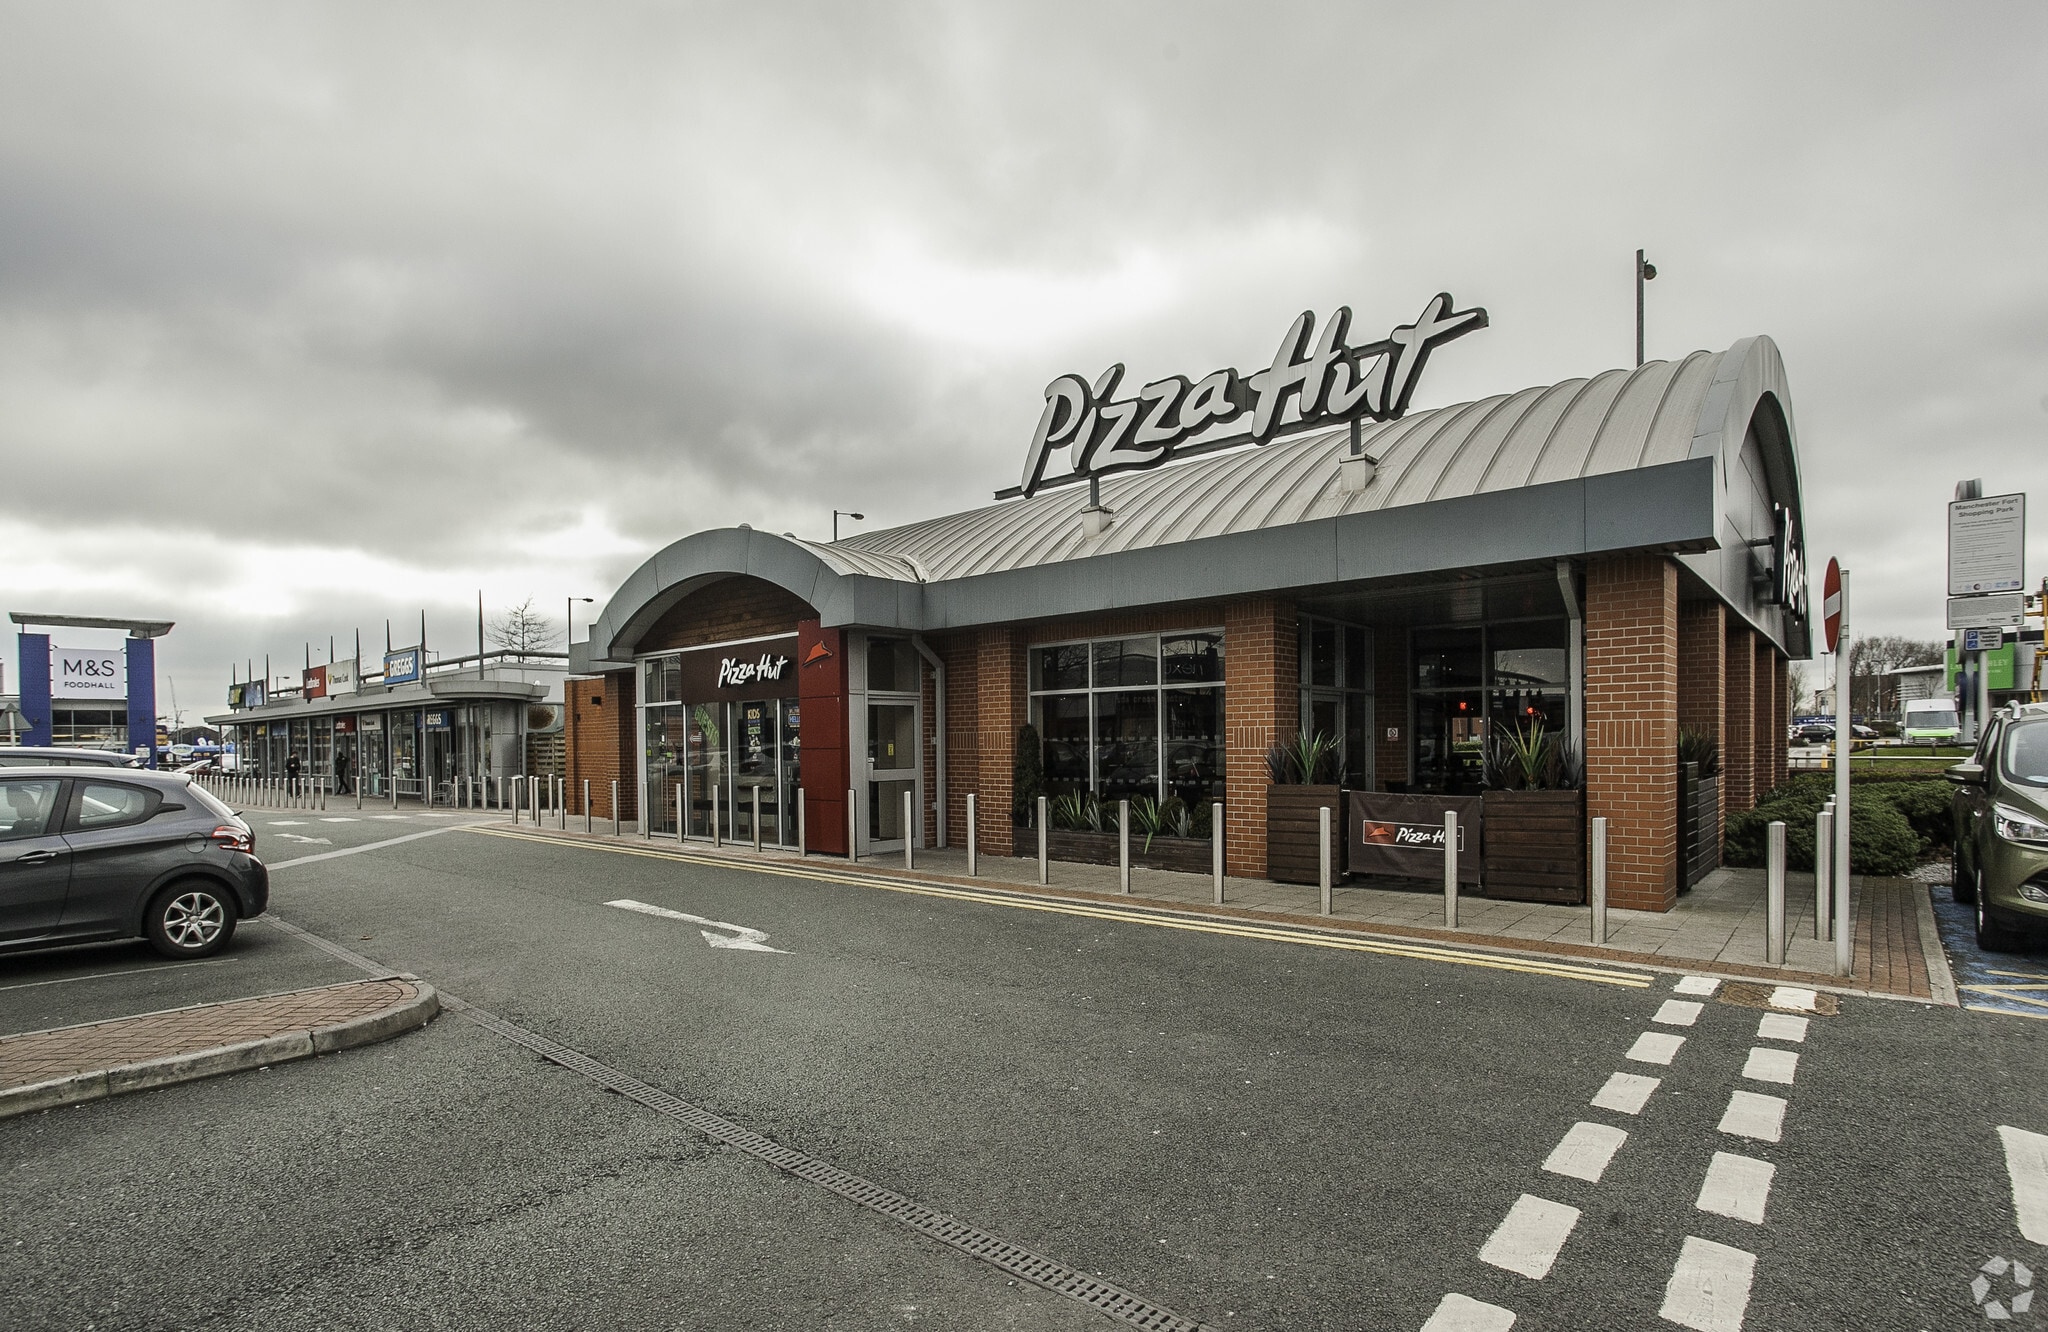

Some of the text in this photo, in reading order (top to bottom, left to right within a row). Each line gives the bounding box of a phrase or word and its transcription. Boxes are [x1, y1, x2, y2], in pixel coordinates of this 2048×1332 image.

[1021, 292, 1489, 499] Pizza Hut
[1955, 500, 2000, 510] Manchester
[1958, 509, 1994, 518] Shopping
[63, 658, 115, 677] M&S
[390, 656, 414, 678] GREGGS
[717, 653, 788, 688] Pizza Hut
[64, 681, 116, 689] FOODHALL
[747, 708, 760, 720] KIDS
[1395, 827, 1432, 844] Pizza
